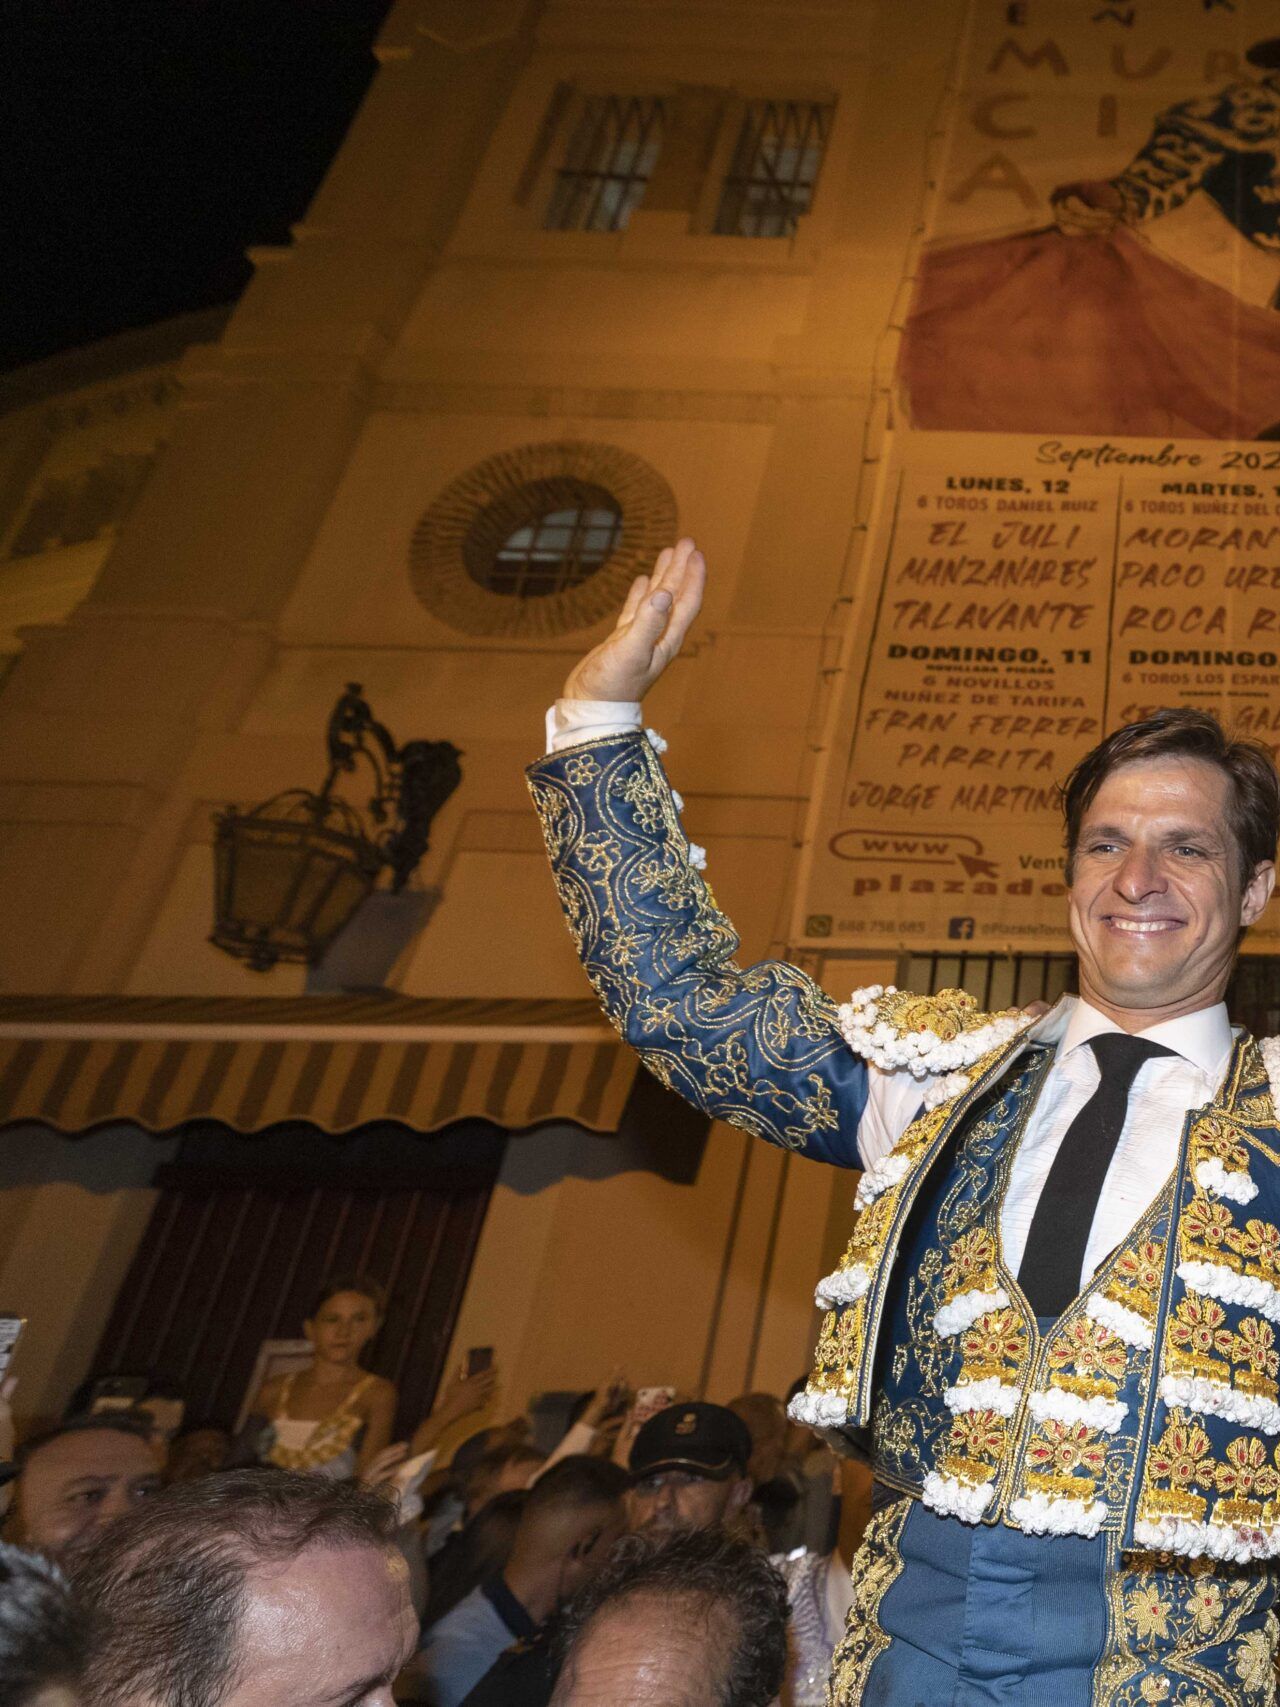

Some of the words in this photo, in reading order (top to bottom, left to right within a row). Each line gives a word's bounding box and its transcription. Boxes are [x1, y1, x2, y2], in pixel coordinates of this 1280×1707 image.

[1036, 441, 1202, 472] Septiembre
[1043, 480, 1070, 493] 12
[917, 496, 927, 508] 6
[936, 497, 989, 511] TOROS
[997, 499, 1053, 512] DANIEL
[1061, 500, 1098, 512] RUIZ
[1125, 501, 1134, 513] 6
[1141, 501, 1185, 514] TOROS
[1245, 503, 1269, 516] DEL
[928, 520, 967, 547] EL
[993, 520, 1080, 549] JULI
[896, 556, 1097, 590] MANZANARES
[1117, 561, 1205, 588] PACO
[893, 600, 1094, 633] TALAVANTE
[1120, 605, 1227, 638] ROCA
[1061, 650, 1092, 664] 11
[923, 675, 936, 687] 6
[946, 677, 1054, 690] NOVILLOS
[1122, 672, 1133, 683] 6
[1141, 673, 1189, 685] TOROS
[1196, 673, 1224, 684] LOS
[972, 694, 999, 705] DE
[1010, 696, 1086, 708] TARIFA
[865, 709, 956, 734] FRAN
[969, 714, 1099, 741] FERRER
[898, 743, 1056, 771] PARRITA
[849, 781, 941, 815] JORGE
[949, 784, 1066, 815] MARTINE
[862, 838, 950, 856] www
[1018, 855, 1068, 870] Vent
